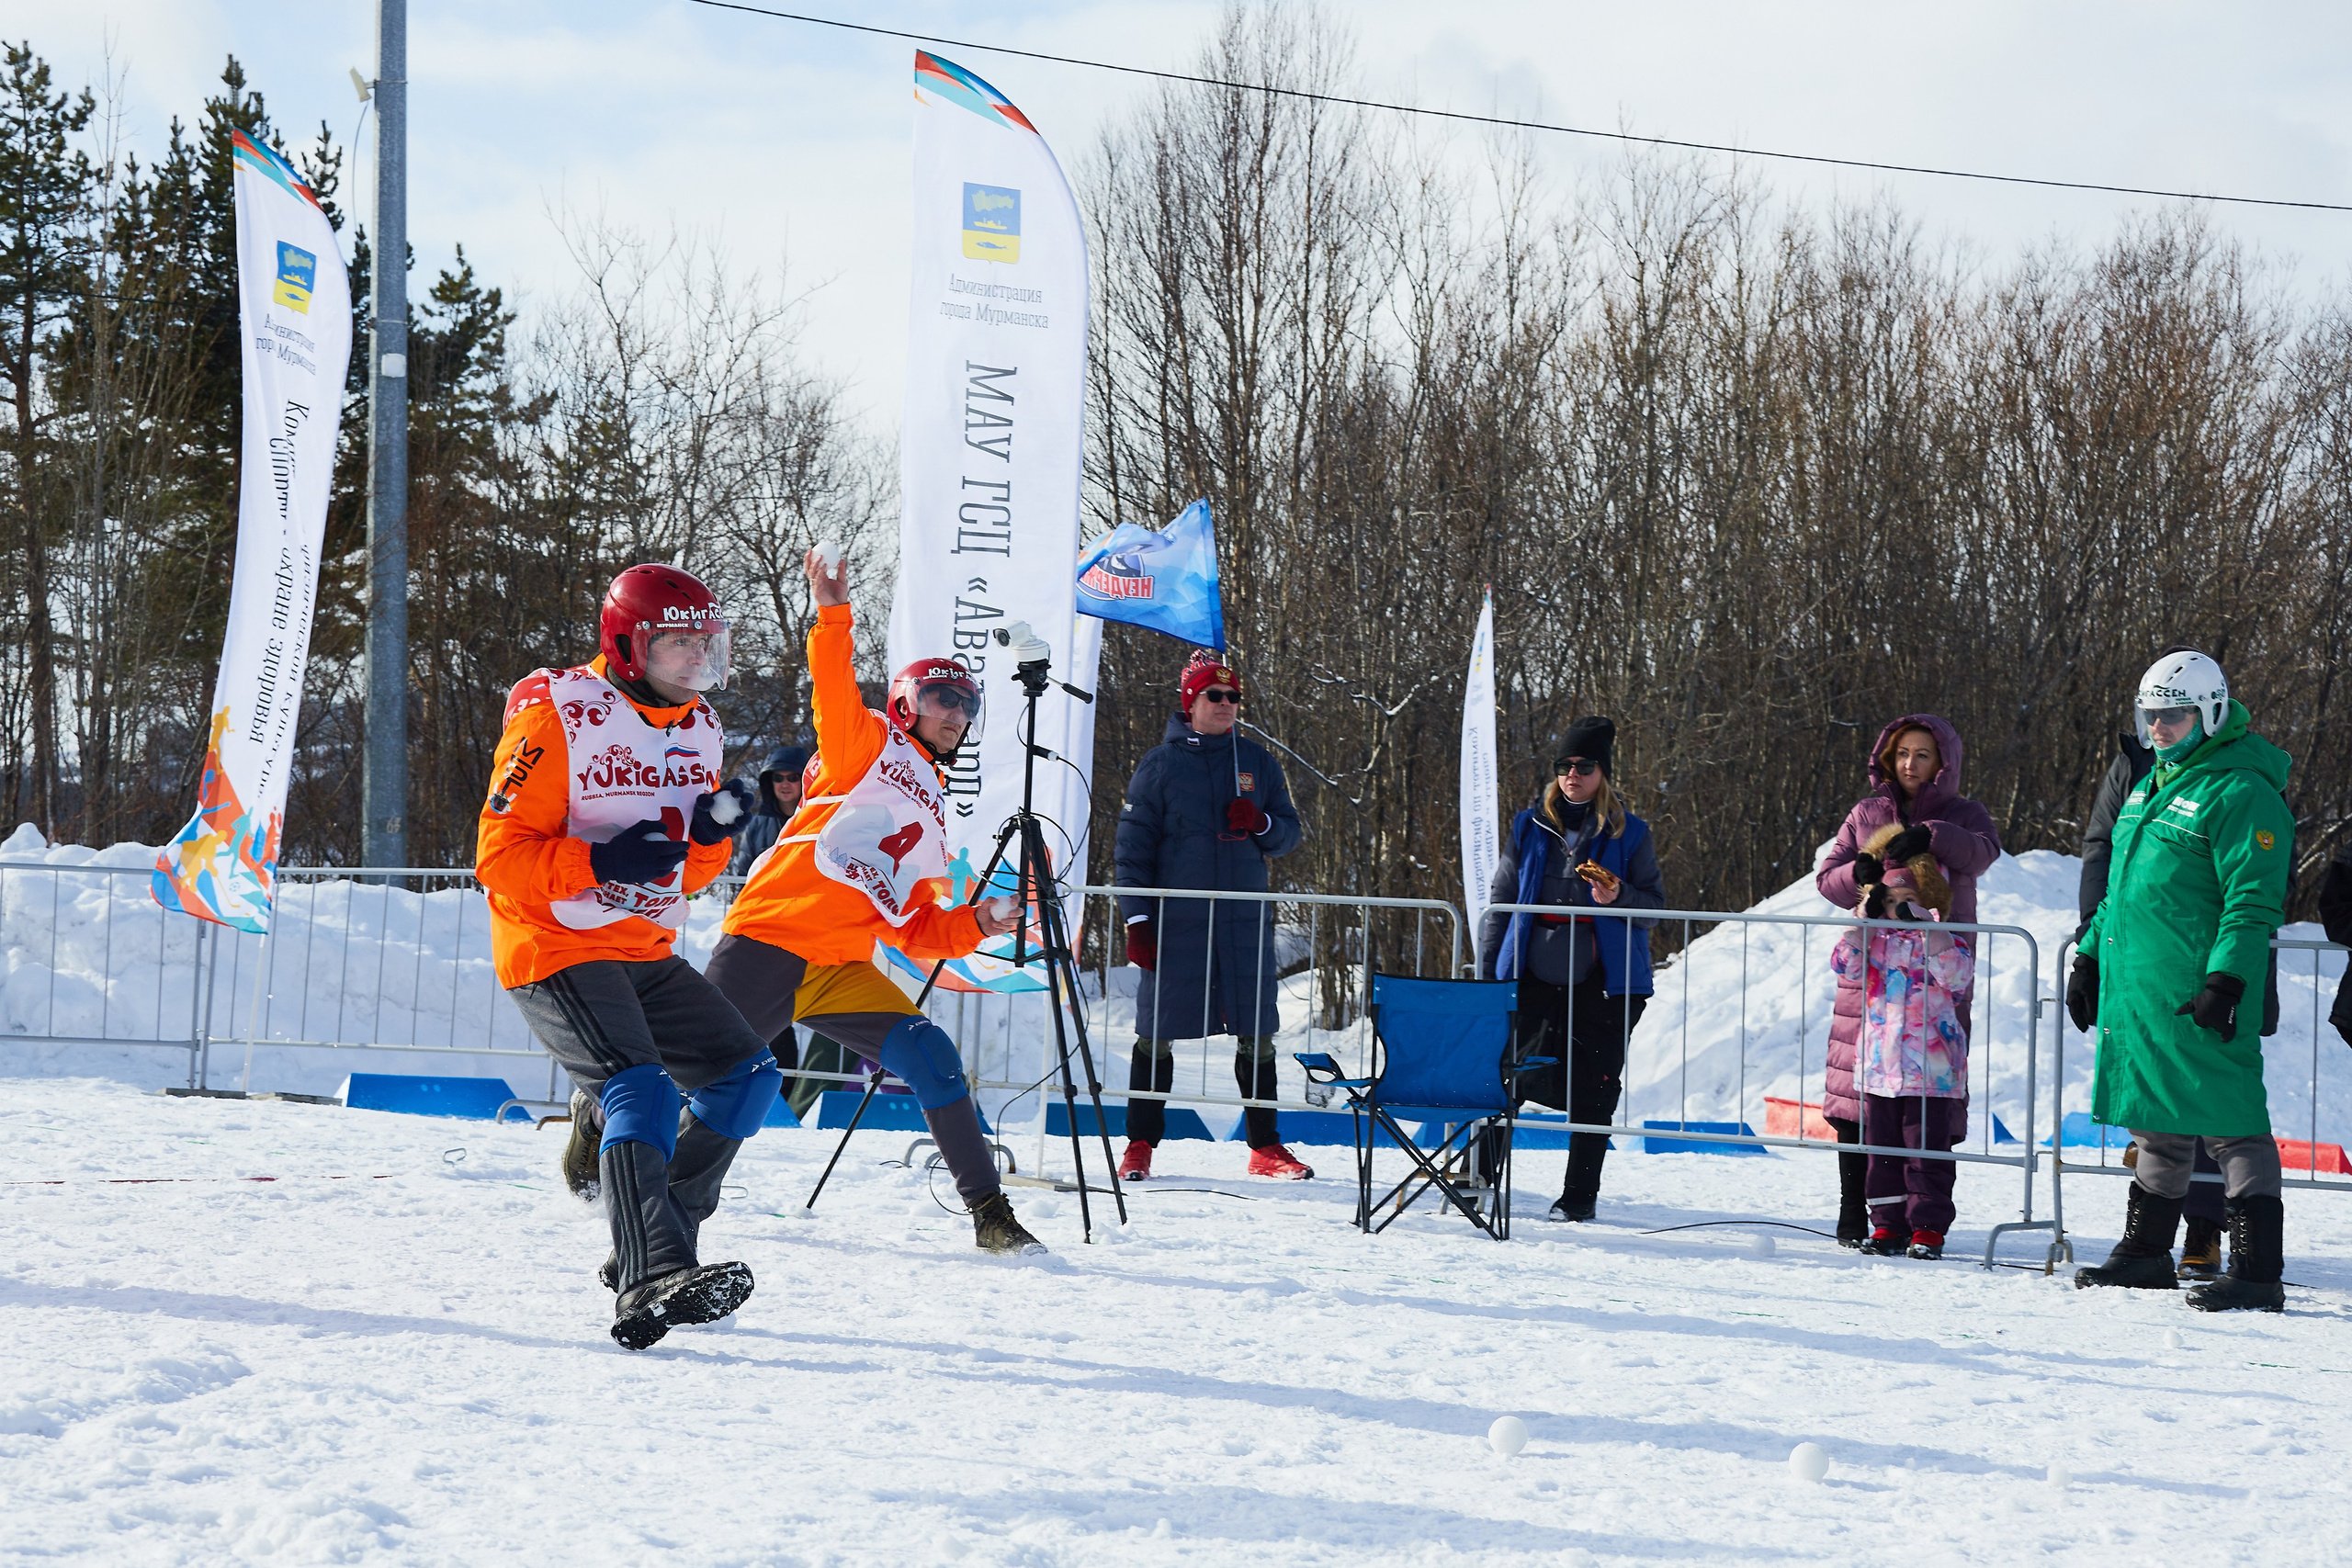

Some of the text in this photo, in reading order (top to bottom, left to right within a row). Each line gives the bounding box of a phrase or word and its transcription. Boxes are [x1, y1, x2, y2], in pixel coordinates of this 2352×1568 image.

[940, 301, 1049, 329] города Мурманска
[948, 273, 1043, 303] Администрация
[964, 359, 1017, 463] МАУ
[950, 475, 1012, 558] ГСЦ
[249, 637, 283, 744] здоровья
